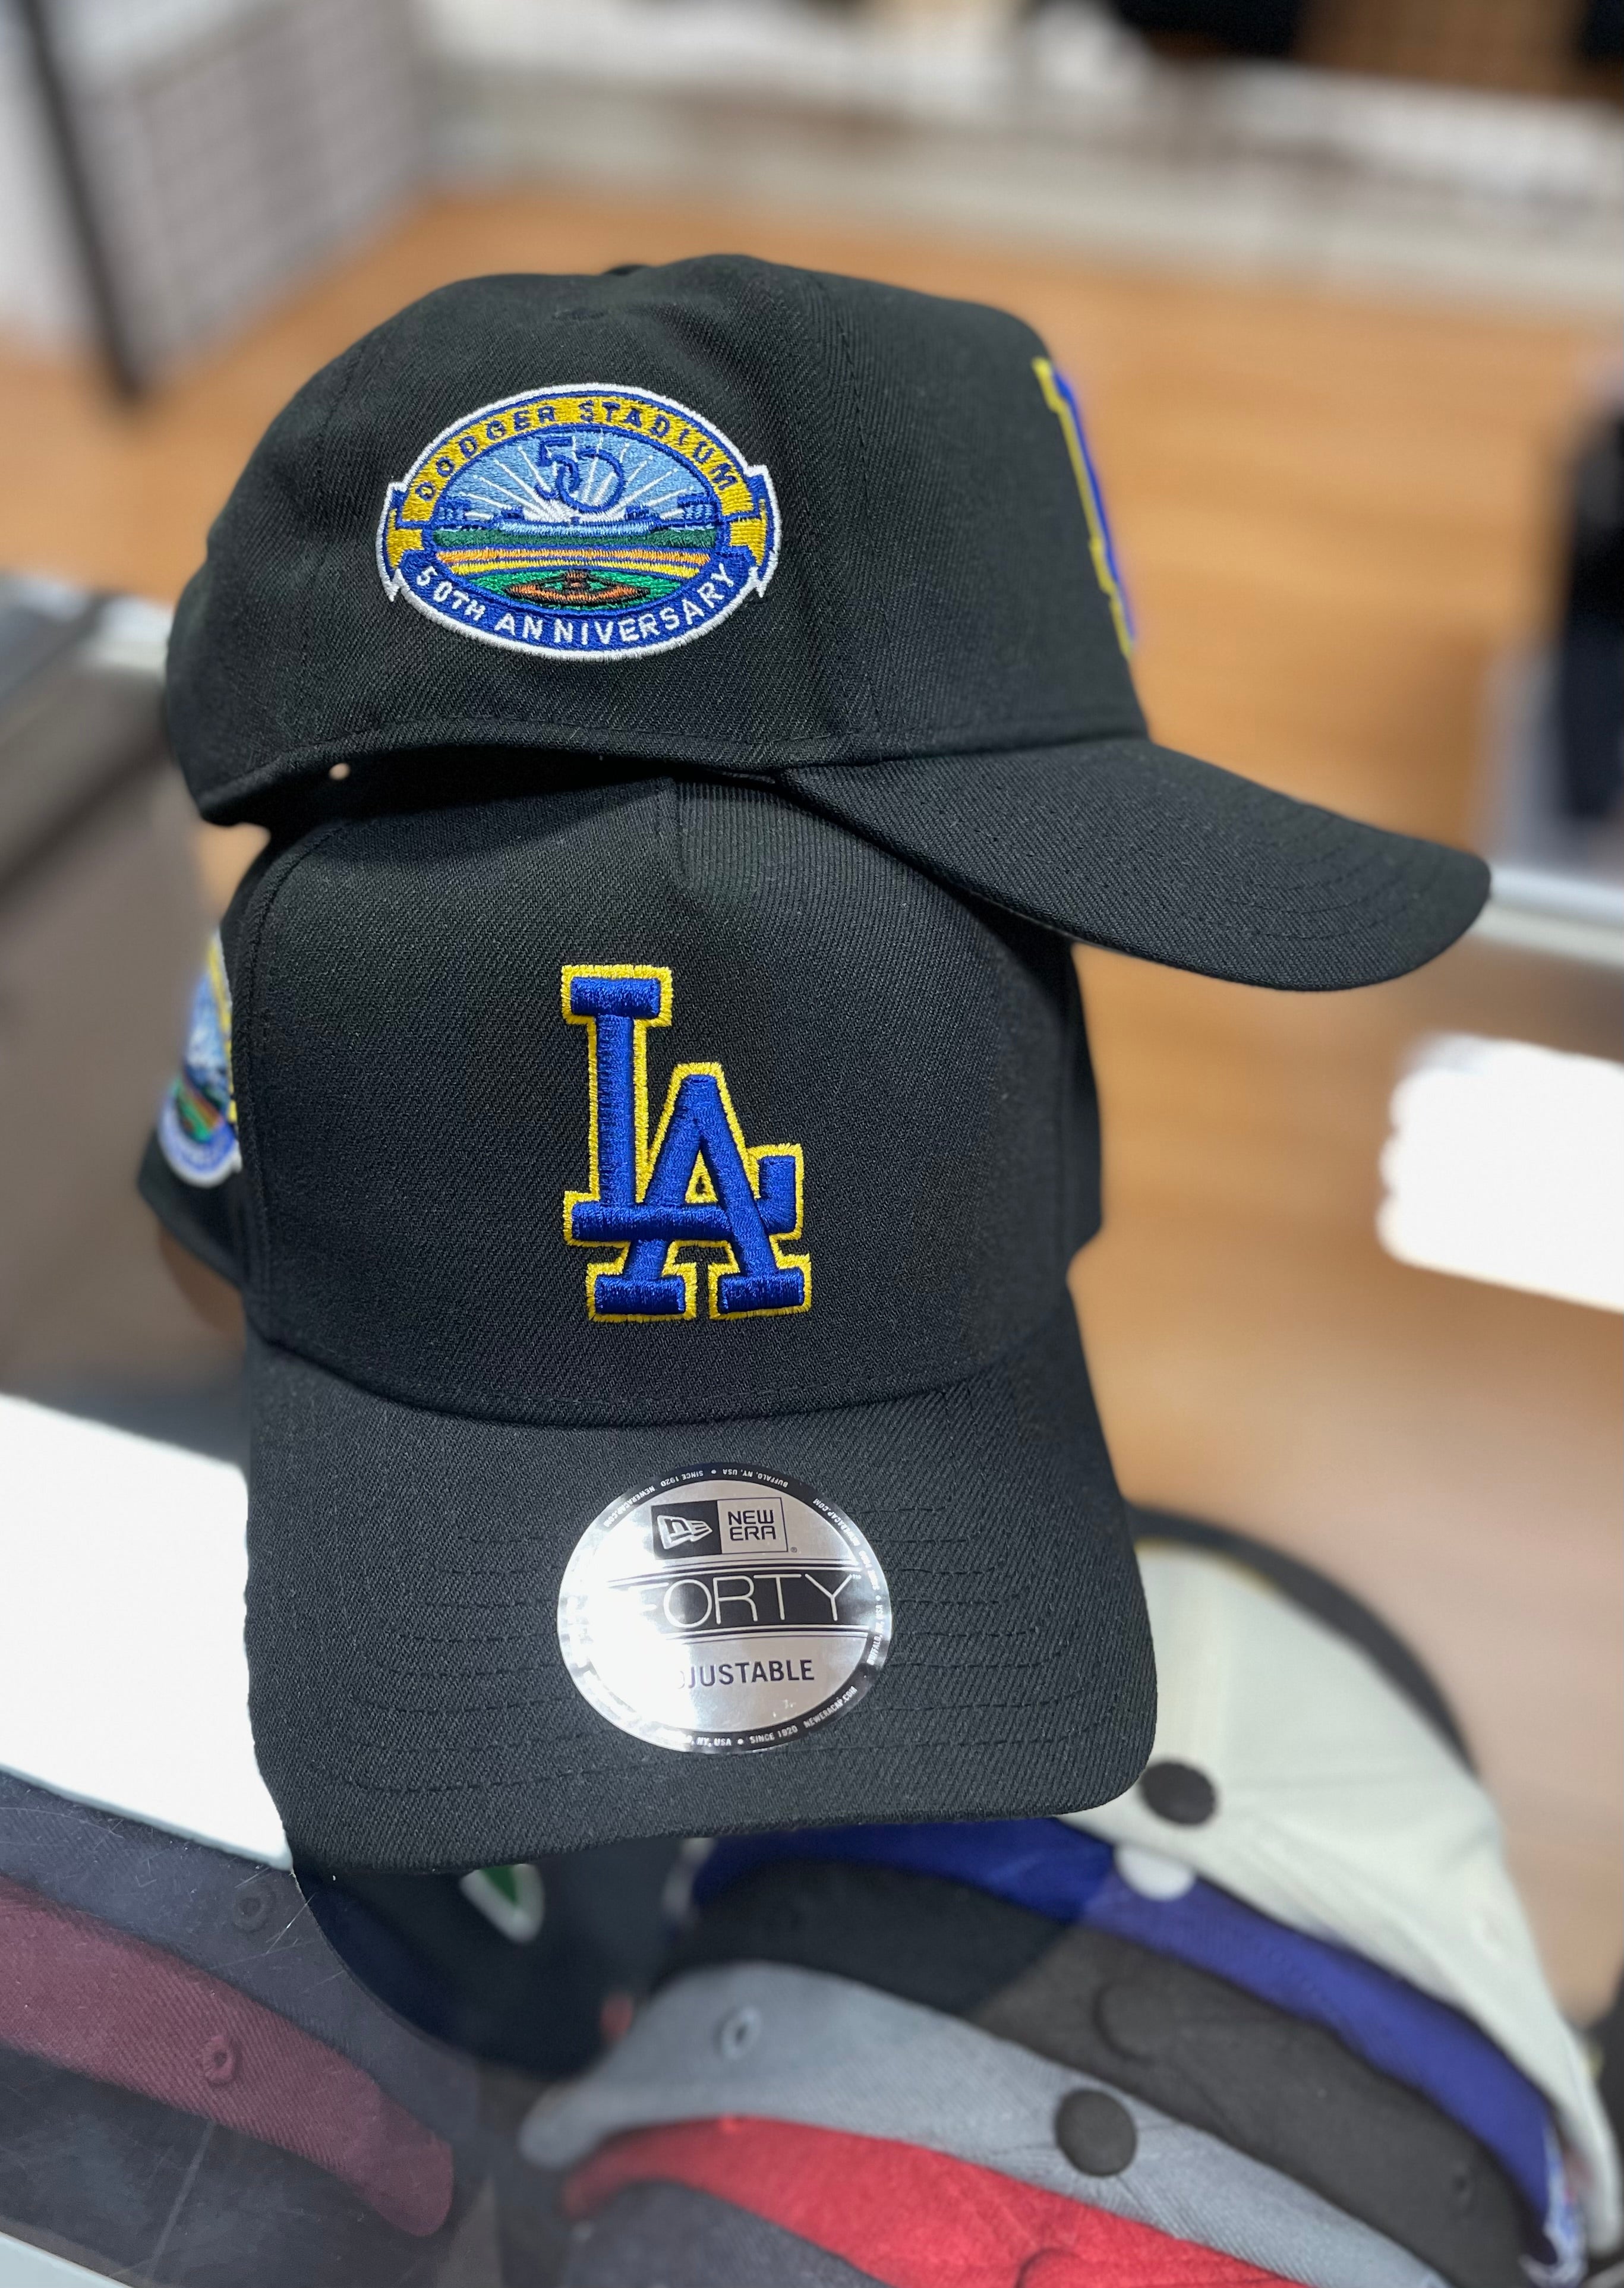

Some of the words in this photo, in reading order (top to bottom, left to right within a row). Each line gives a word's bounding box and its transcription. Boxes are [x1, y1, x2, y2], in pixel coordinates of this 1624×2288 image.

[415, 405, 556, 501] DODGER
[578, 400, 738, 491] STADIUM
[535, 435, 626, 512] 50
[417, 566, 486, 621] 50TH
[494, 563, 734, 645] ANNIVERSARY
[562, 964, 812, 1323] LA
[660, 1476, 680, 1487] 1920
[682, 1470, 704, 1481] SINCE
[728, 1509, 774, 1526] NEW
[730, 1526, 777, 1541] ERA
[714, 1738, 731, 1746] USA
[749, 1732, 775, 1744] SINCE
[777, 1725, 798, 1738] 1920
